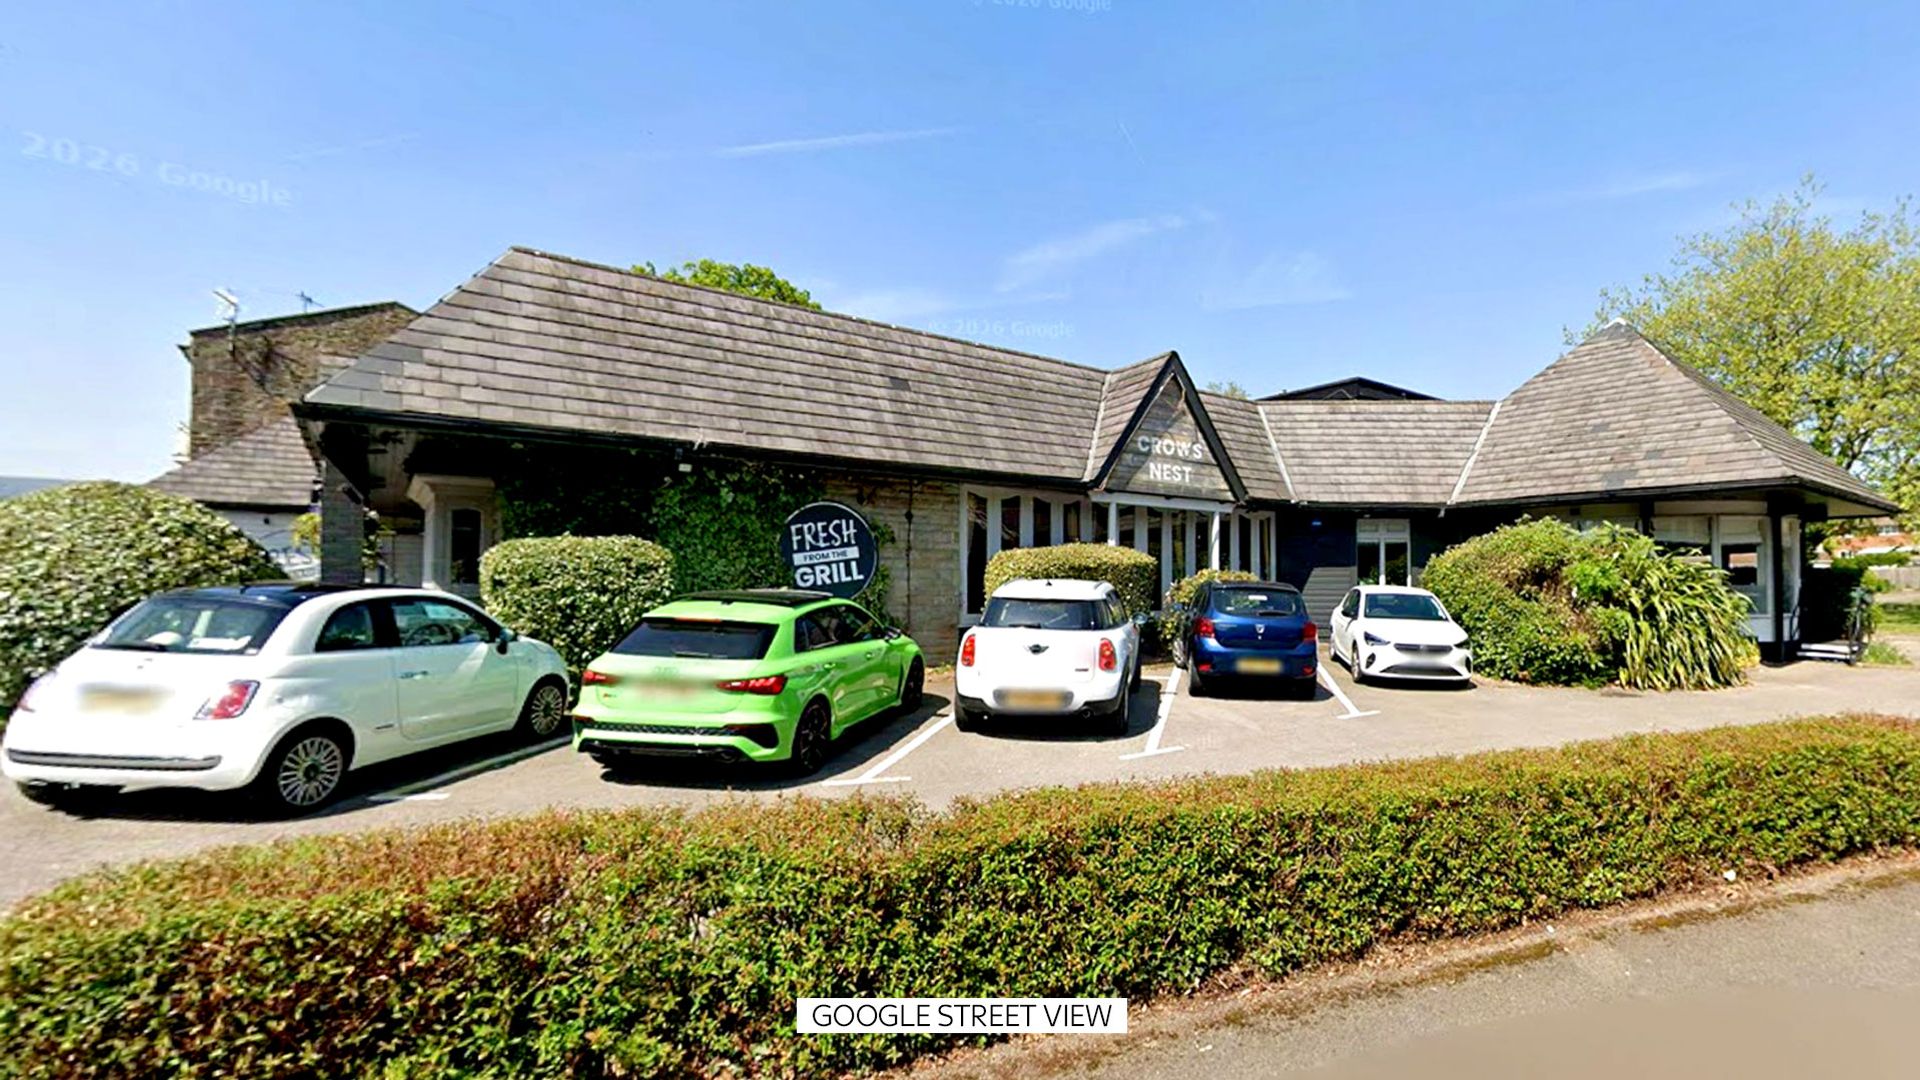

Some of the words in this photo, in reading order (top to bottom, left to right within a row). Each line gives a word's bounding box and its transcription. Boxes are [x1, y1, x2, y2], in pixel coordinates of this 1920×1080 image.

[1137, 435, 1203, 460] CROWS
[1148, 462, 1193, 483] NEST
[790, 519, 857, 551] FRESH
[803, 552, 831, 562] FROM
[832, 549, 849, 559] THE
[794, 560, 865, 588] GRILL
